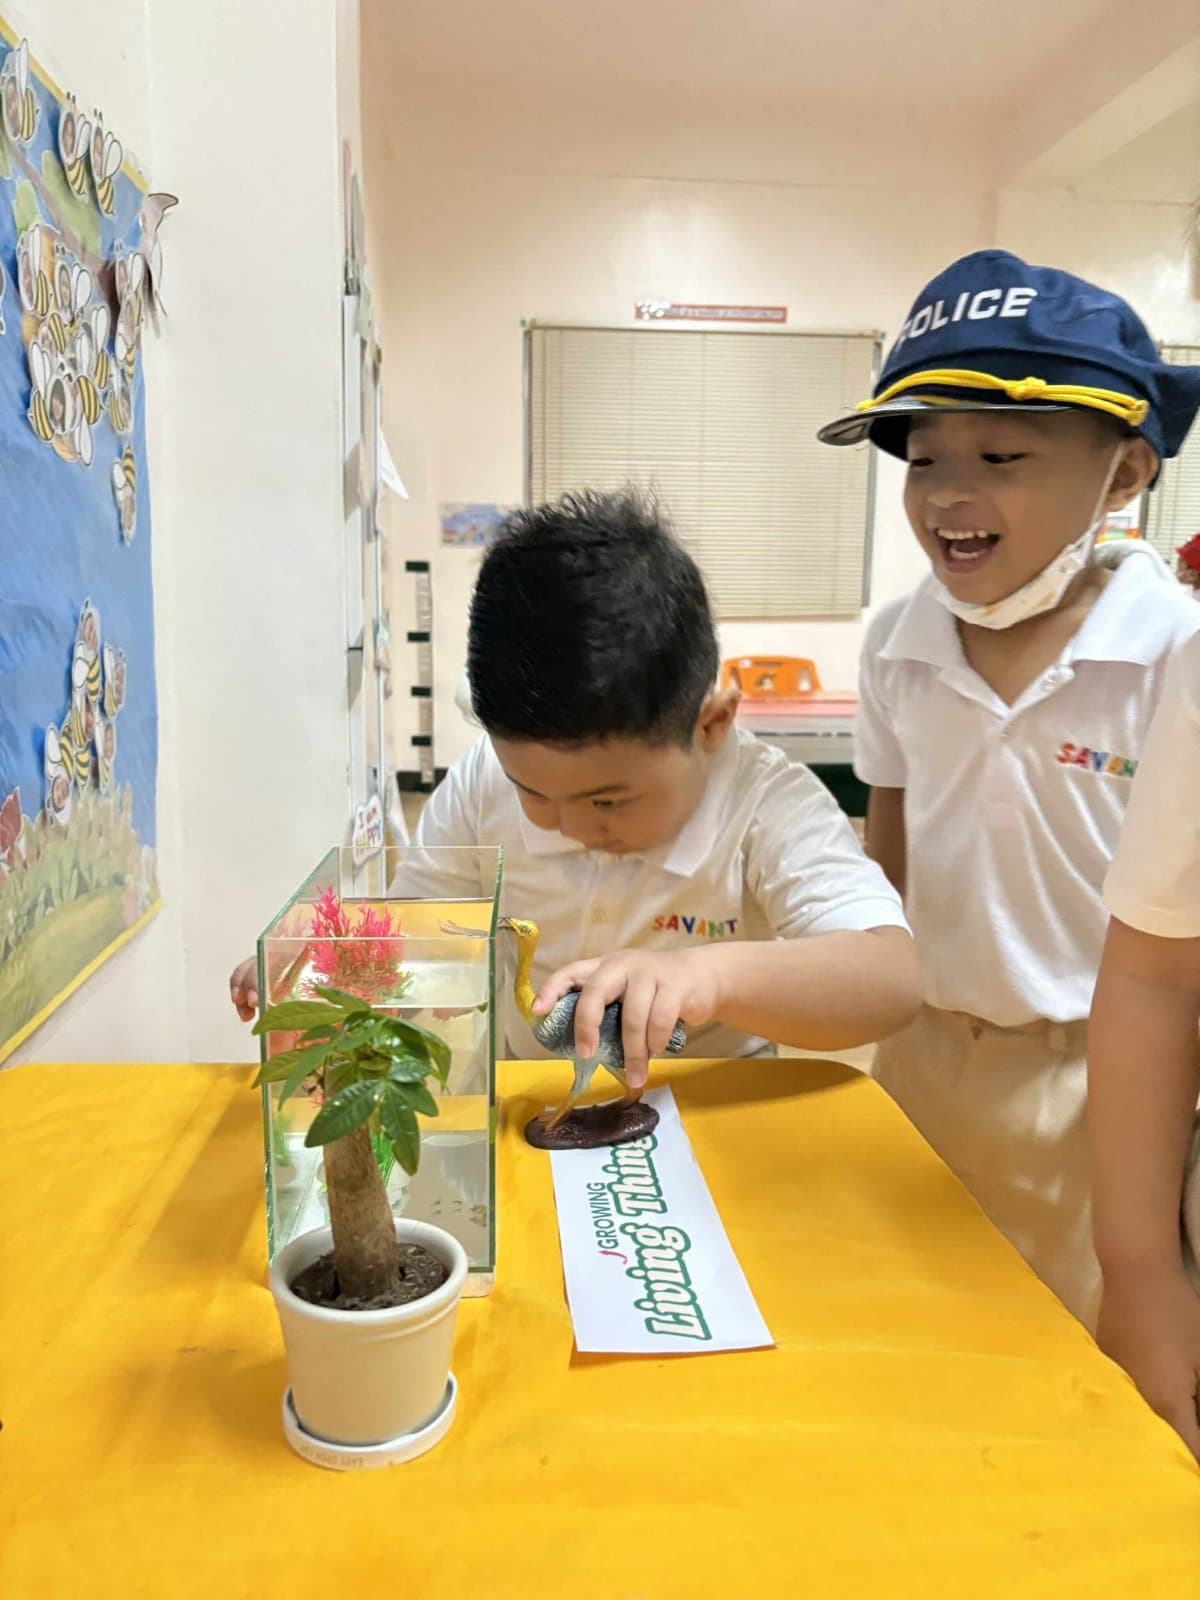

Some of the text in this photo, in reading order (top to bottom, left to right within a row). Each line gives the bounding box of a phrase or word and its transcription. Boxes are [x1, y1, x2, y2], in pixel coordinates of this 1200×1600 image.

[651, 914, 738, 937] SAVANT
[586, 1182, 619, 1249] GROWING
[618, 1222, 712, 1340] Living
